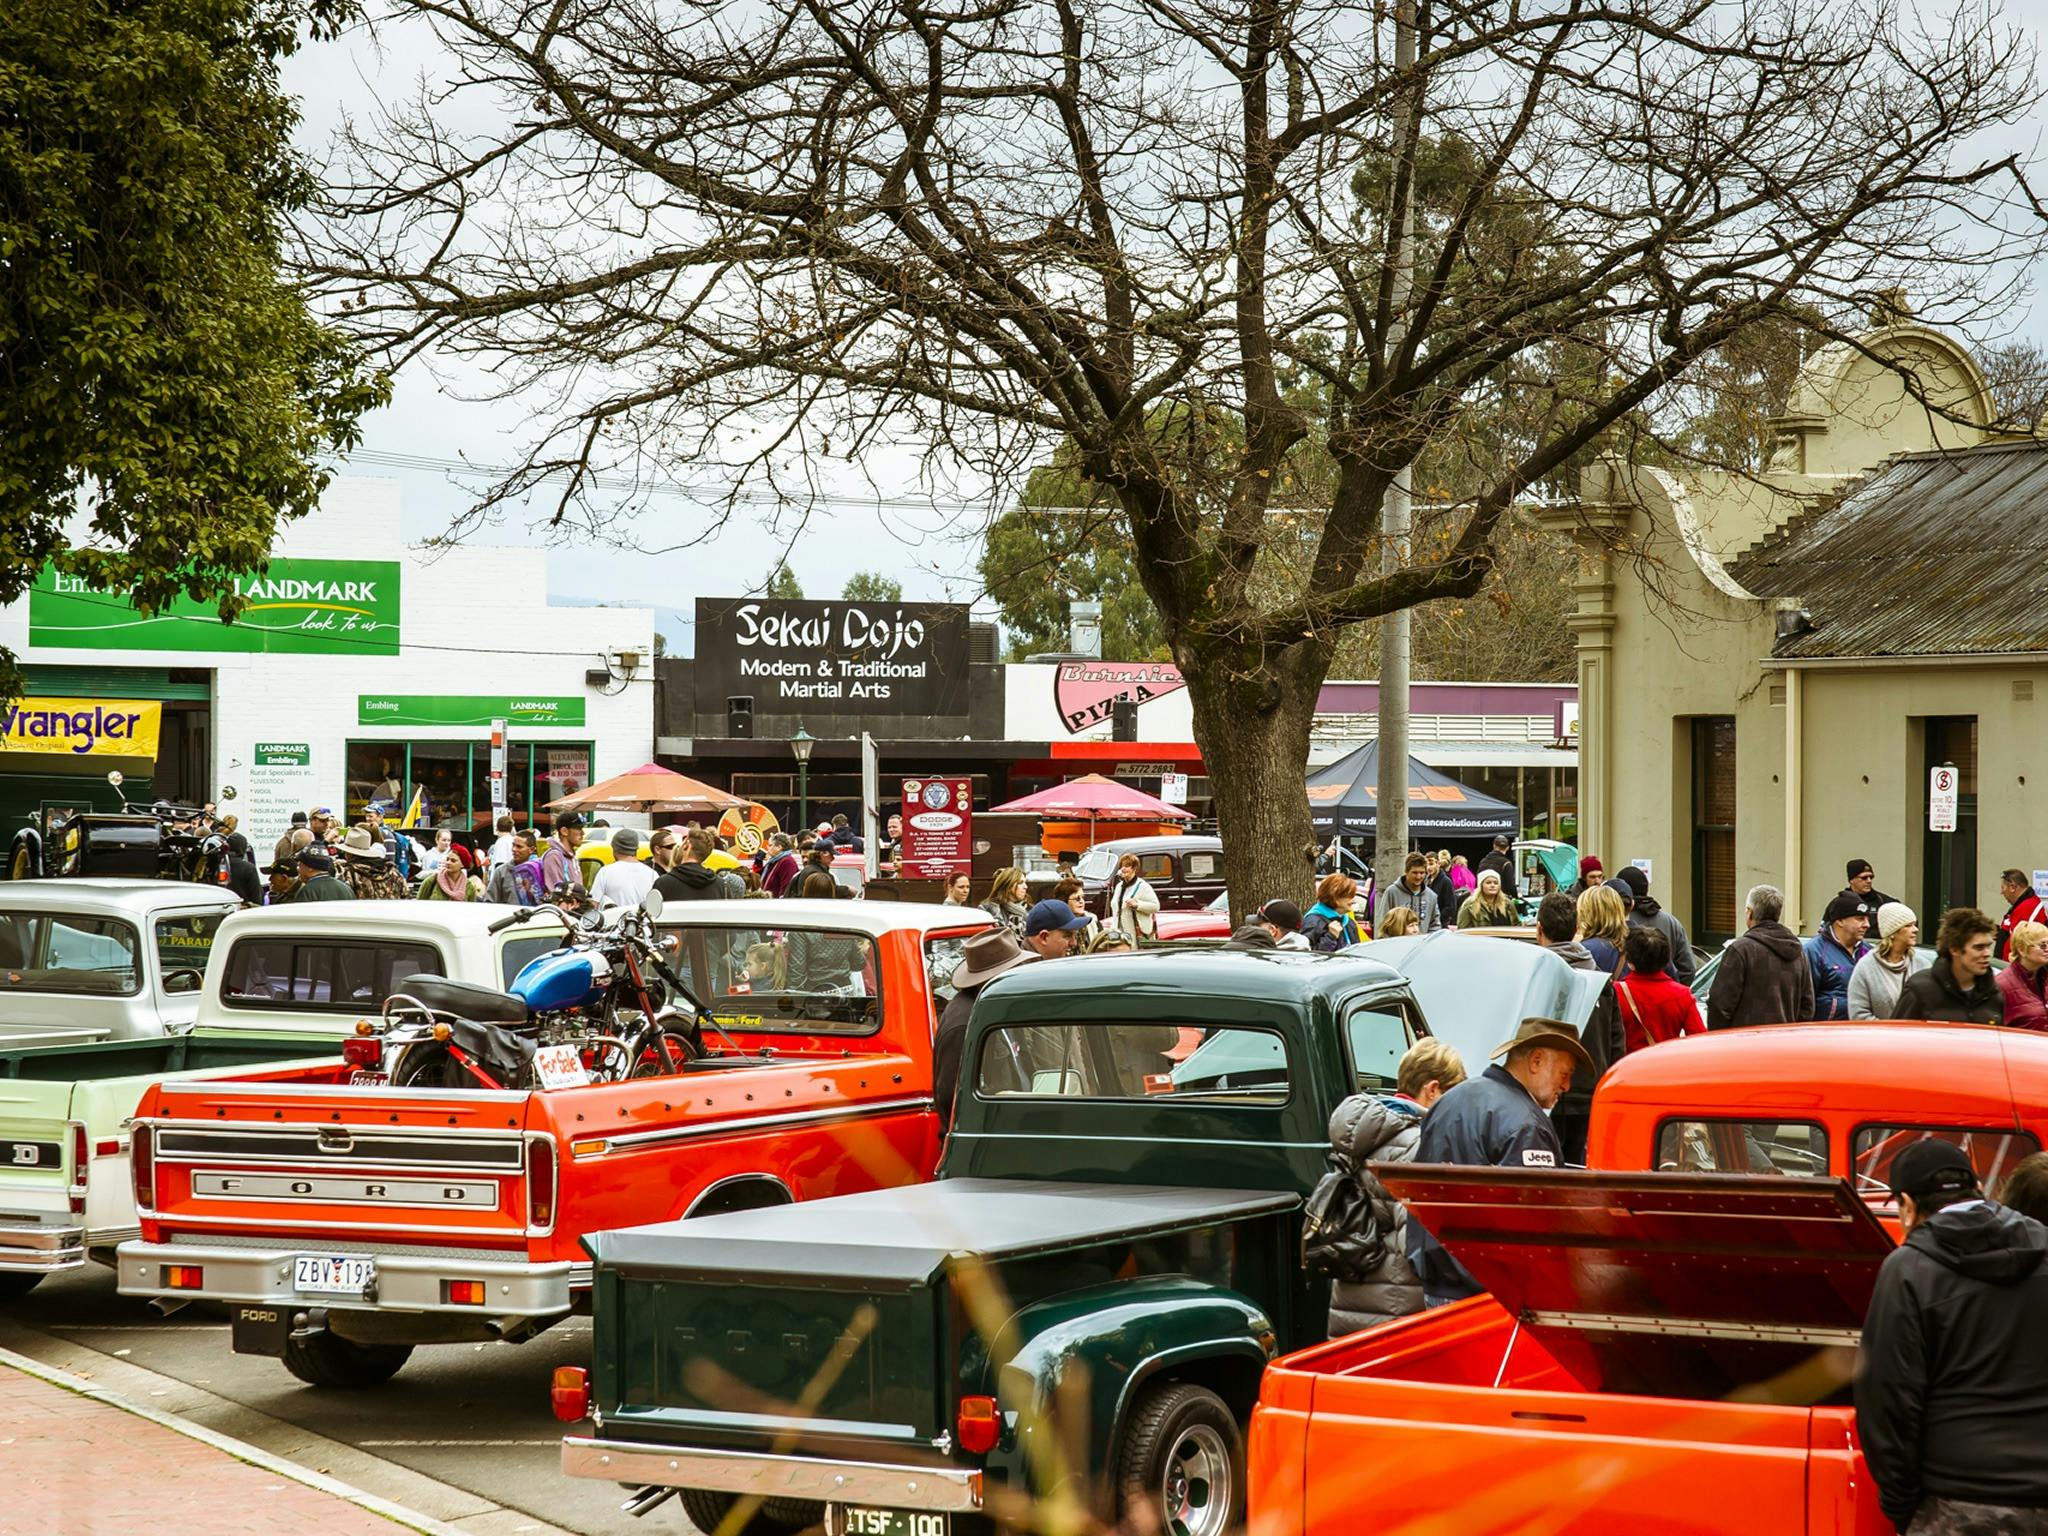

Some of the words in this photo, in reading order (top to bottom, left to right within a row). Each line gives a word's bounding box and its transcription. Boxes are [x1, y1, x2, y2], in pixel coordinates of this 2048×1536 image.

[234, 578, 377, 602] LANDMARK
[301, 609, 336, 631] look
[736, 604, 831, 648] Sekai
[842, 608, 925, 660] Dojo
[740, 658, 811, 677] Modern
[817, 660, 833, 677] &
[838, 660, 926, 678] Traditional
[780, 681, 843, 699] Martial
[850, 682, 891, 699] Arts
[366, 701, 399, 711] Embling
[510, 702, 558, 710] LANDMARK
[260, 745, 306, 753] LANDMARK
[268, 756, 298, 766] Embling
[1129, 765, 1150, 773] 5772
[1152, 765, 1174, 774] 2693
[269, 769, 302, 777] Specialists
[740, 1016, 761, 1025] Ford
[539, 1054, 558, 1079] For
[556, 1050, 578, 1075] Sale
[12, 1144, 39, 1164] D
[1528, 1152, 1552, 1164] Jeep
[222, 1178, 465, 1200] FORD
[299, 1261, 330, 1283] ZBV
[240, 1309, 278, 1322] FORD
[854, 1509, 893, 1535] TSF
[909, 1514, 944, 1536] 100
